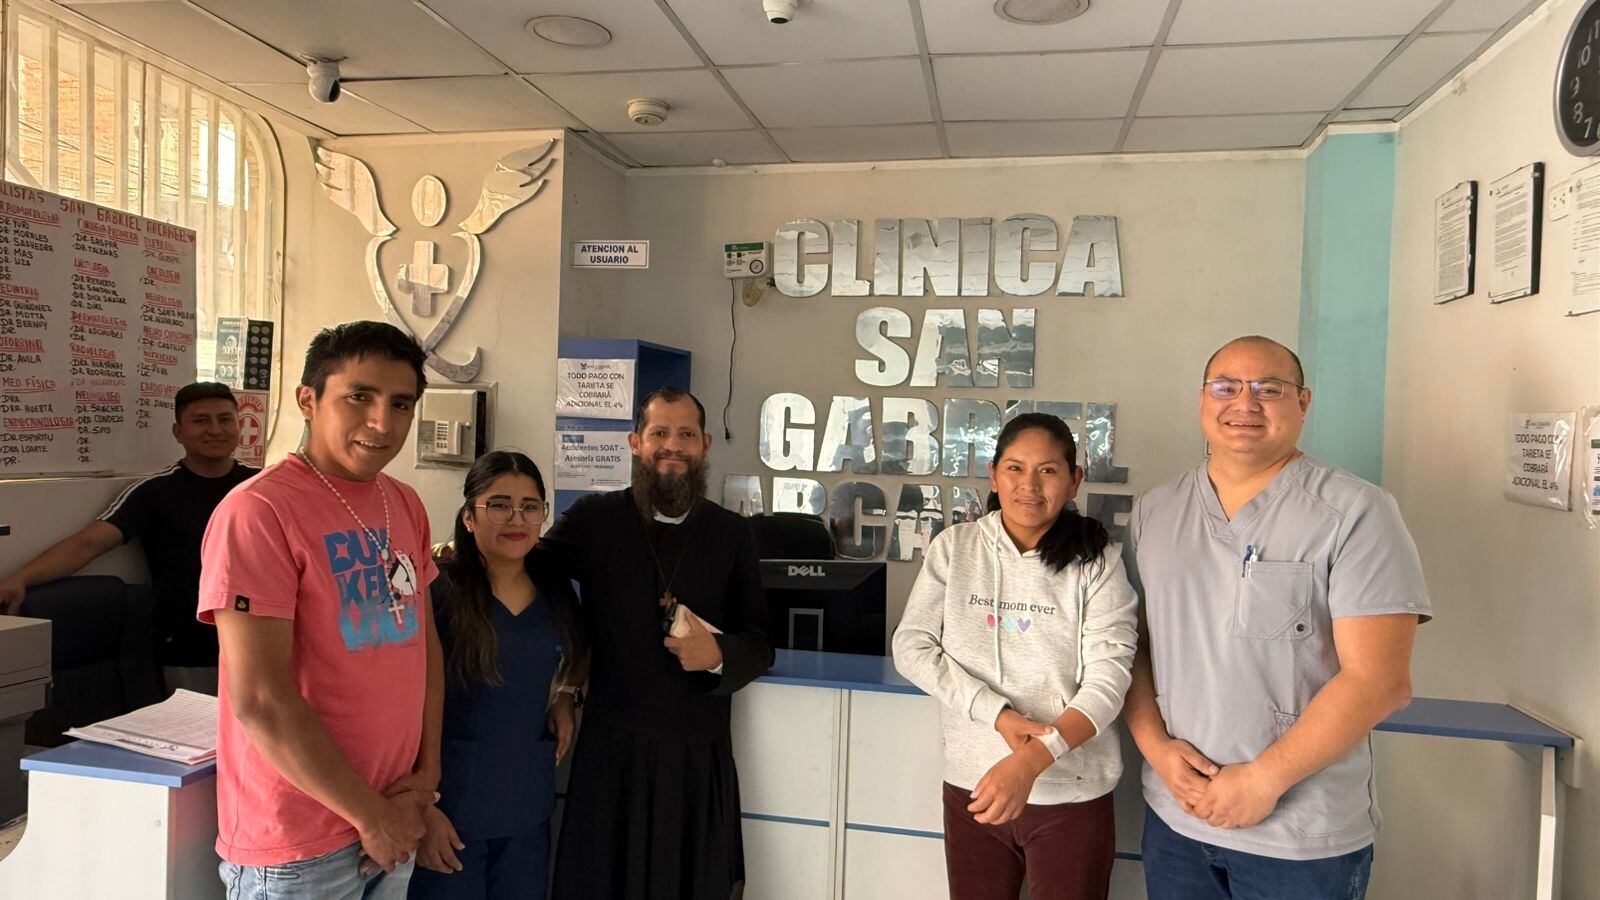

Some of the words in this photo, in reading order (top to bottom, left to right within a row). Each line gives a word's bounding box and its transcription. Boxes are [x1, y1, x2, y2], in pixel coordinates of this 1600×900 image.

[1569, 76, 1581, 98] 9
[1572, 101, 1584, 124] 8
[1584, 116, 1594, 139] 7
[60, 198, 85, 216] SAN
[97, 208, 142, 232] GABRIEL
[14, 249, 34, 259] MAS
[581, 245, 625, 254] ATENCION
[627, 246, 638, 254] AL
[590, 256, 629, 264] USUARIO
[774, 213, 1124, 298] CLINICA
[855, 307, 1037, 388] SAN
[788, 565, 826, 577] DELL
[968, 594, 994, 607] Best
[998, 600, 1027, 611] mom
[1030, 603, 1056, 615] ever
